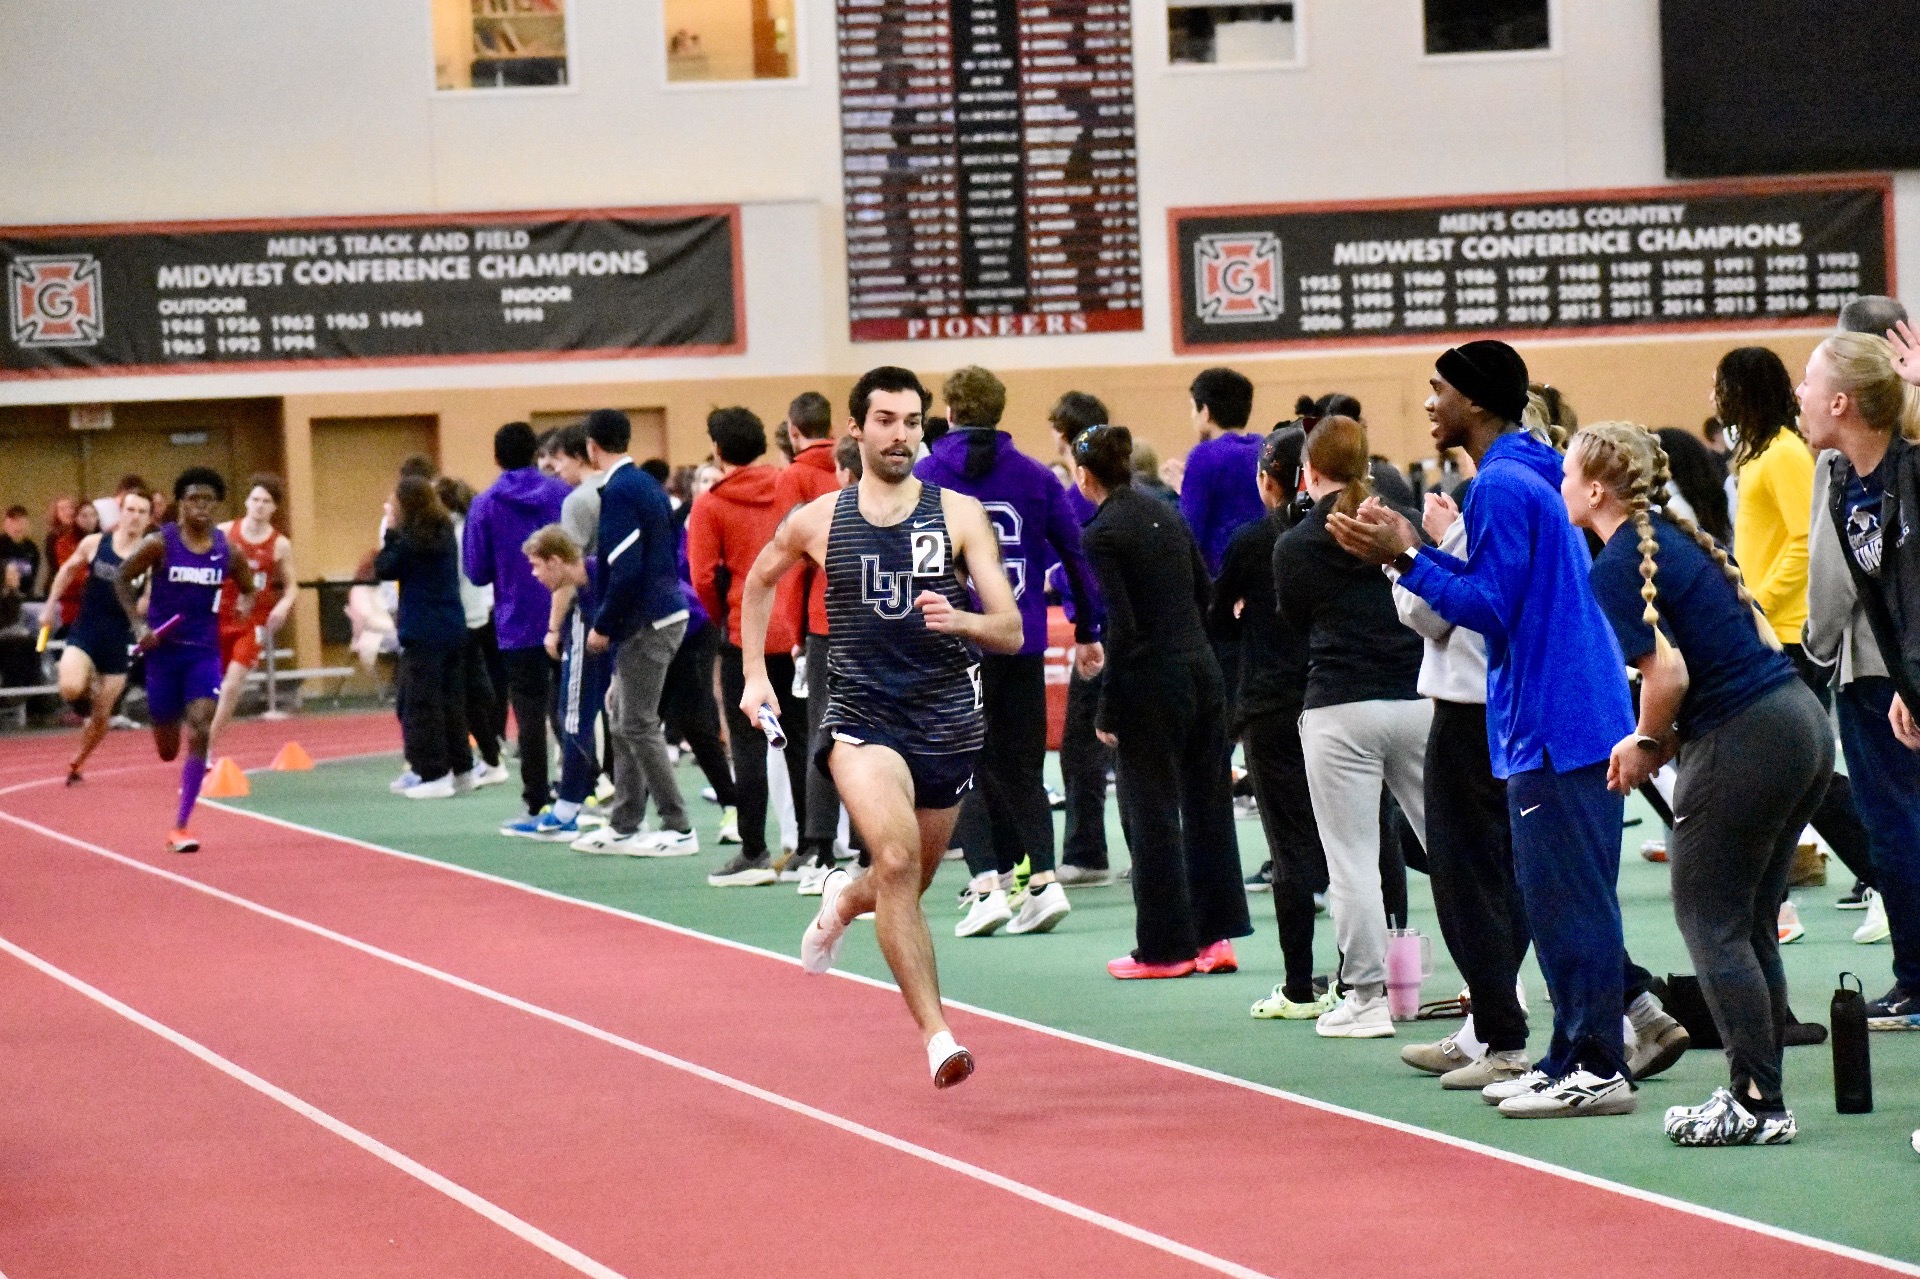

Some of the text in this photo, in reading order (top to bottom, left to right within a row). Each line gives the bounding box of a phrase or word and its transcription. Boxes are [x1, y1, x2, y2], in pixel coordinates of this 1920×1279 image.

[1440, 206, 1684, 232] MEN'S CROSS COUNTRY
[268, 231, 529, 256] MEN'S TRACK AND FIELD
[1334, 224, 1802, 265] MIDWEST CONFERENCE CHAMPIONS
[158, 250, 648, 288] MIDWEST CONFERENCE CHAMPIONS
[1508, 267, 1547, 282] 1987
[159, 297, 246, 315] OUTDOOR
[501, 286, 572, 302] INDOOR
[907, 313, 1087, 338] PIONEERS
[914, 534, 941, 574] 2
